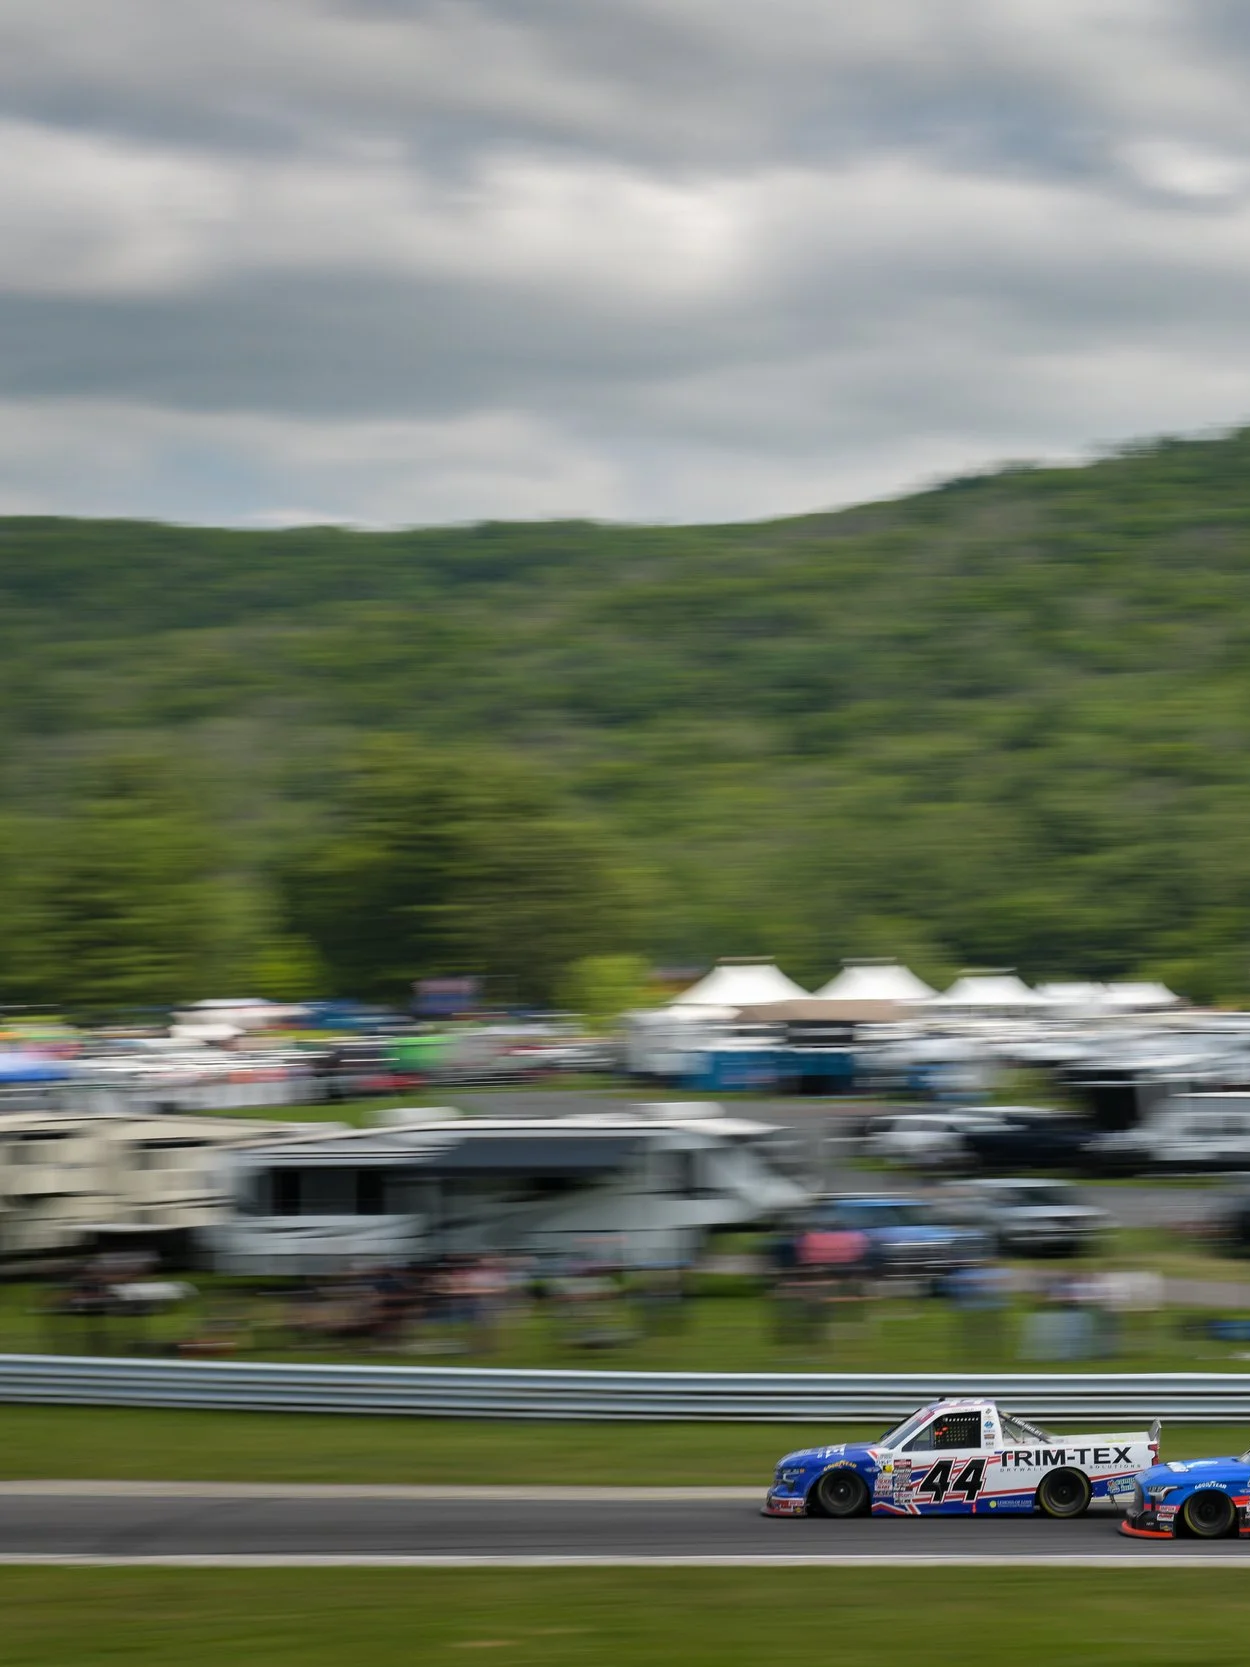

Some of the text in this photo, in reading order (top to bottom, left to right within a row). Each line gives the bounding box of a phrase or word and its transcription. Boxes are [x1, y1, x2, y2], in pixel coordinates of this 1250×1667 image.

[1001, 1446, 1132, 1467] TRIM-TEX
[823, 1459, 857, 1472] GOODYEAR
[917, 1456, 989, 1504] 44
[1195, 1480, 1227, 1490] GOODYEAR
